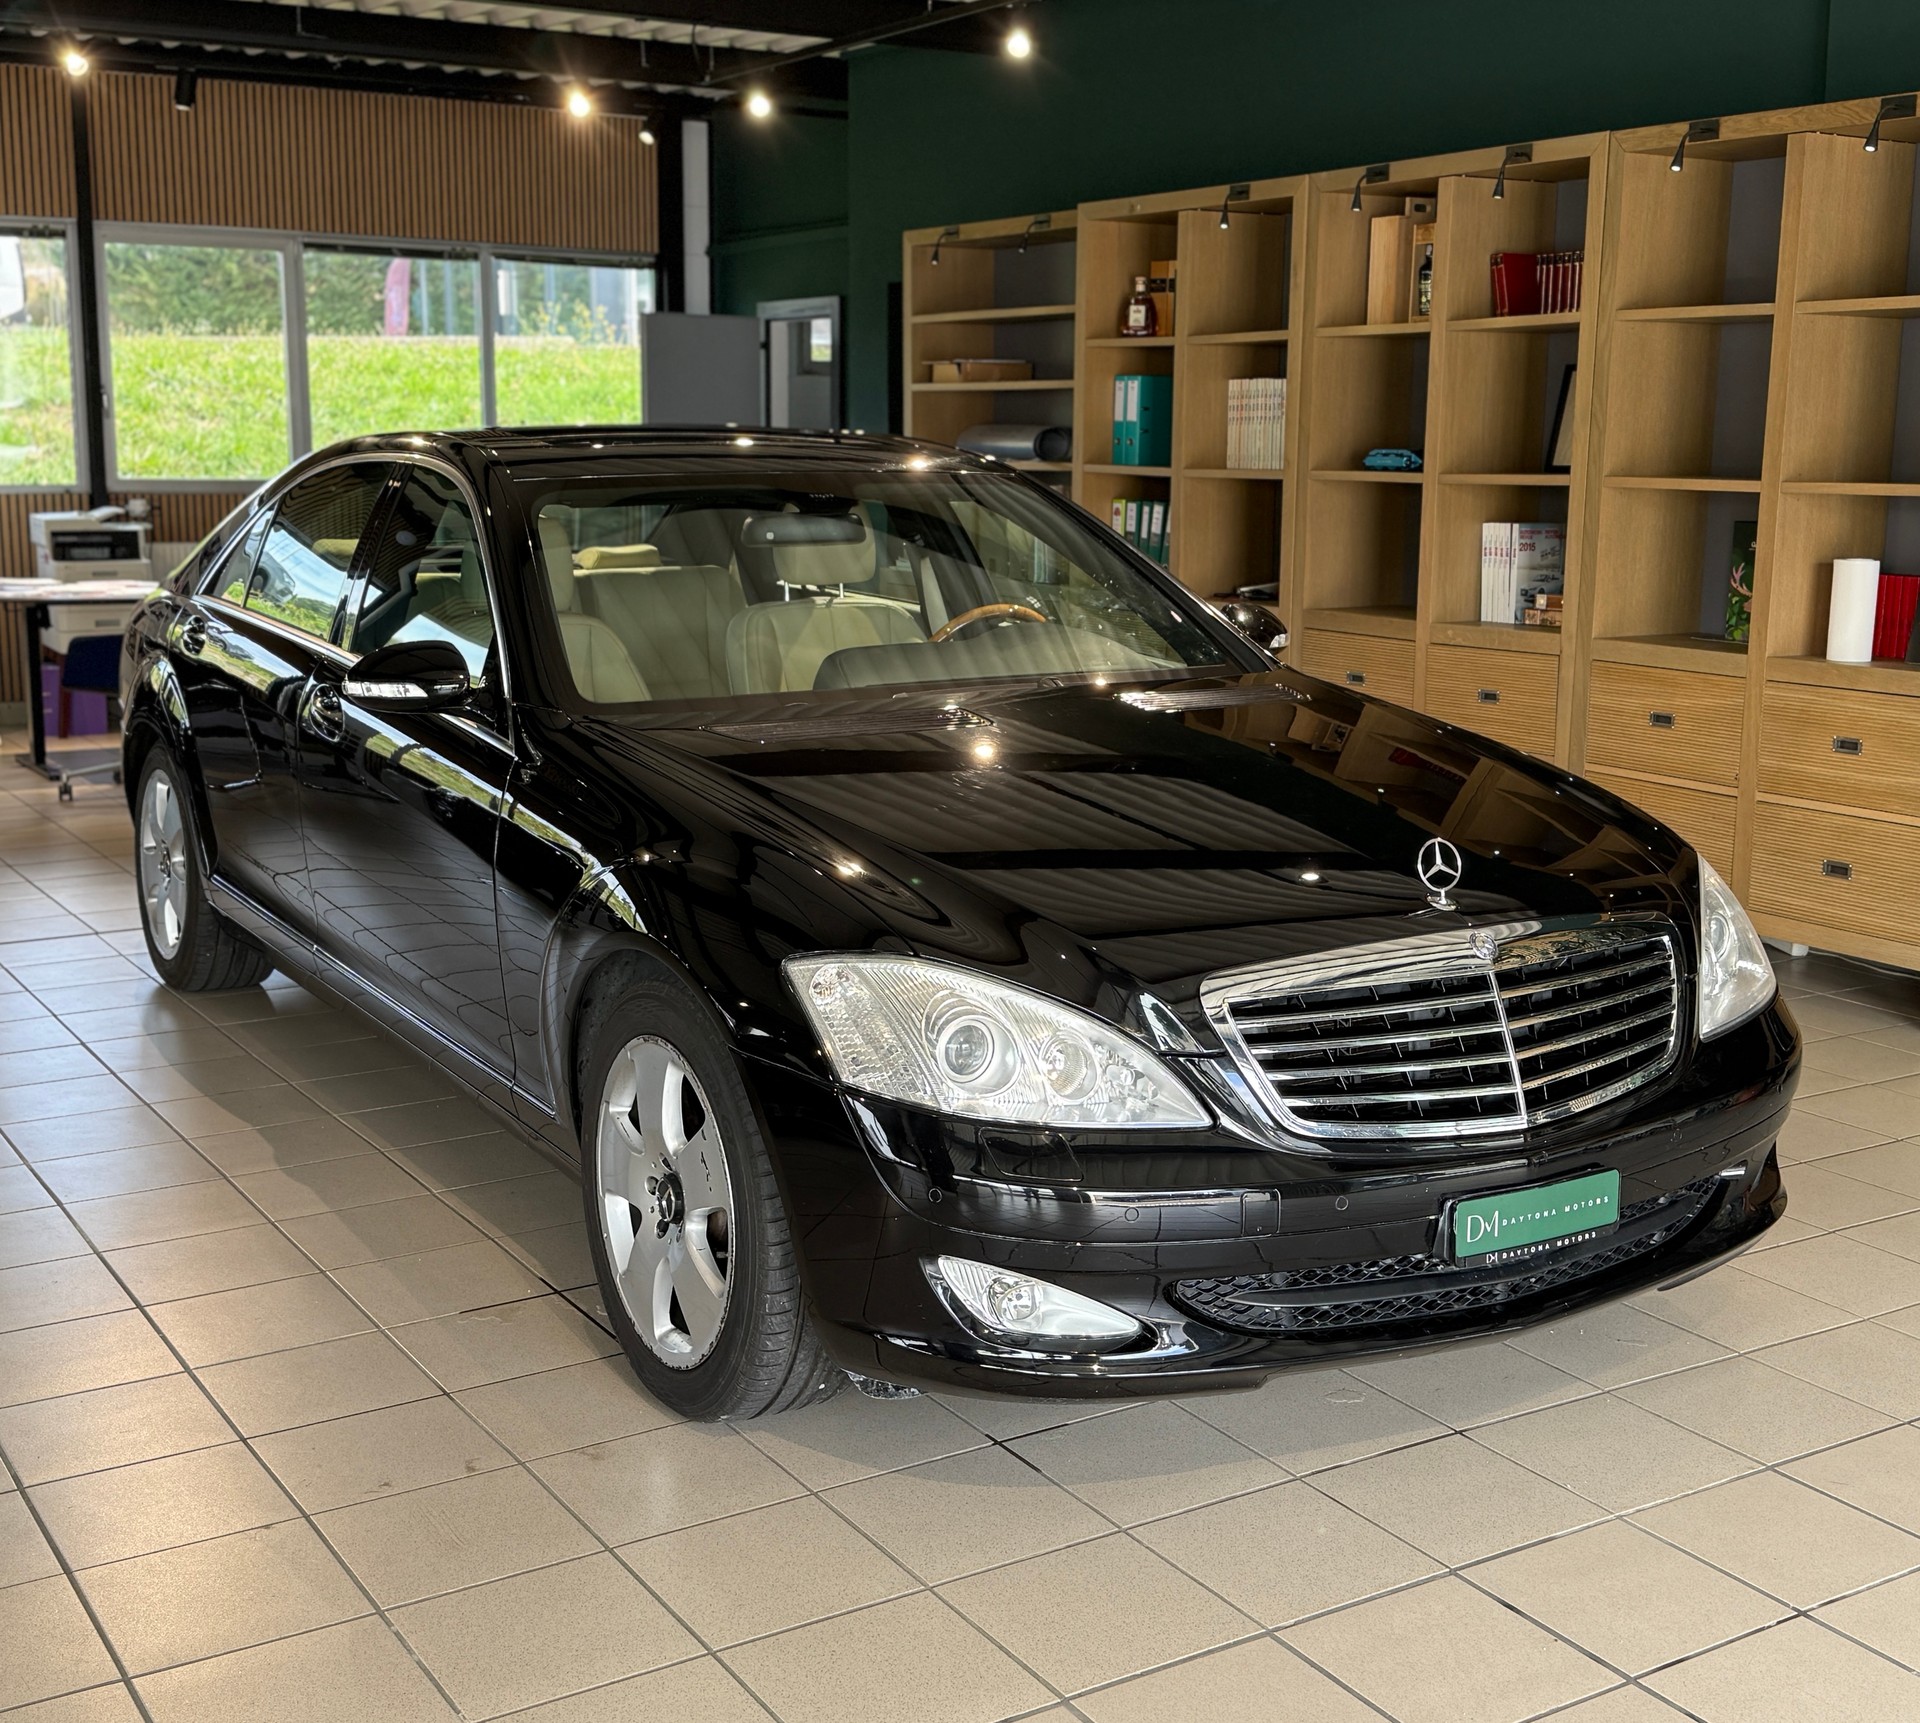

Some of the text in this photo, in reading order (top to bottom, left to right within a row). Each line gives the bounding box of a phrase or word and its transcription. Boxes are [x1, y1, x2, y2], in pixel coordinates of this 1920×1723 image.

[1519, 542, 1536, 552] 2015
[1466, 1195, 1609, 1243] DM DAYTONA MOTORS
[1502, 1243, 1550, 1259] DAYTONA
[1556, 1231, 1597, 1247] MOTORS
